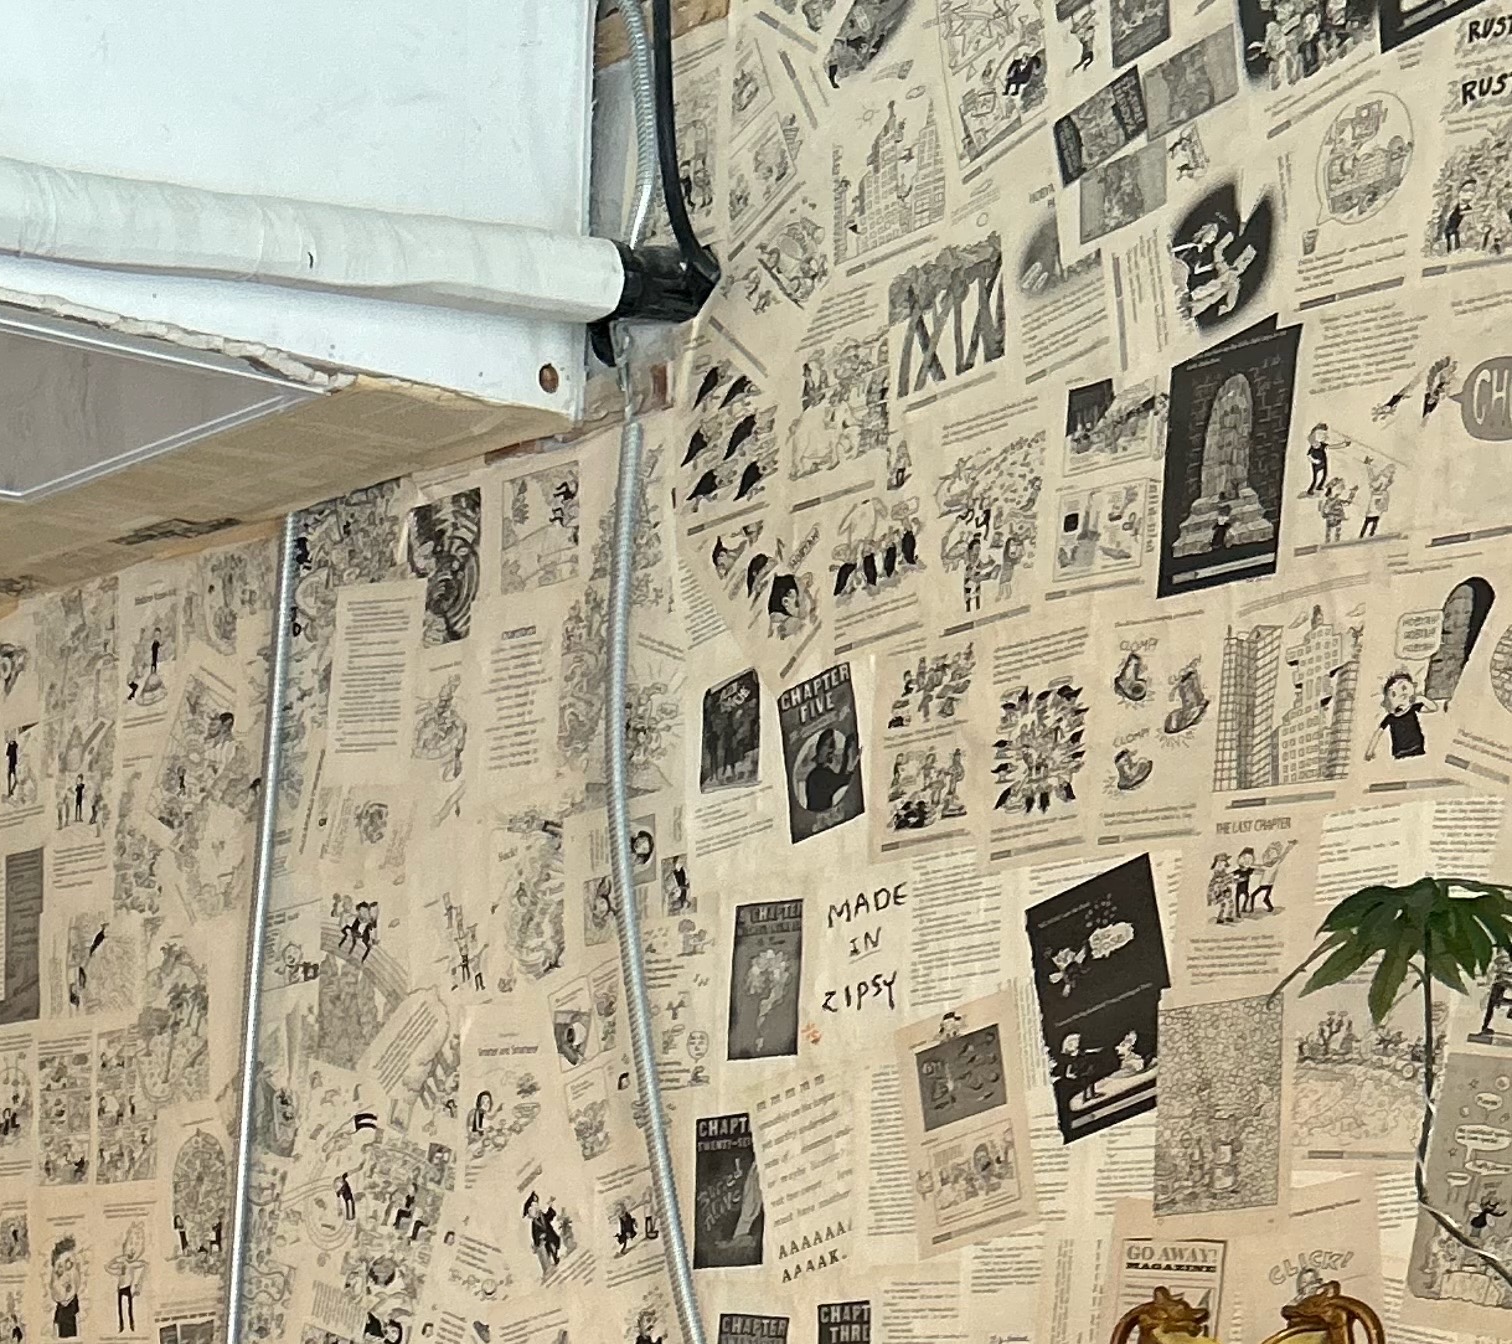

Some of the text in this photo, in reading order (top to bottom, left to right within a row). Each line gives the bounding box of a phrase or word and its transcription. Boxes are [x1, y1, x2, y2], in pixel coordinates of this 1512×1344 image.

[1461, 71, 1512, 105] RUS
[780, 663, 850, 711] CHAPTER
[799, 691, 835, 723] FIVE
[827, 881, 908, 928] MADE
[849, 927, 882, 957] IN
[821, 970, 898, 1013] ZIPSY
[1125, 1262, 1217, 1274] MAGAZINE
[1126, 1245, 1155, 1261] GO
[1268, 1249, 1355, 1286] CLICK!
[721, 1316, 788, 1337] CHAPTER
